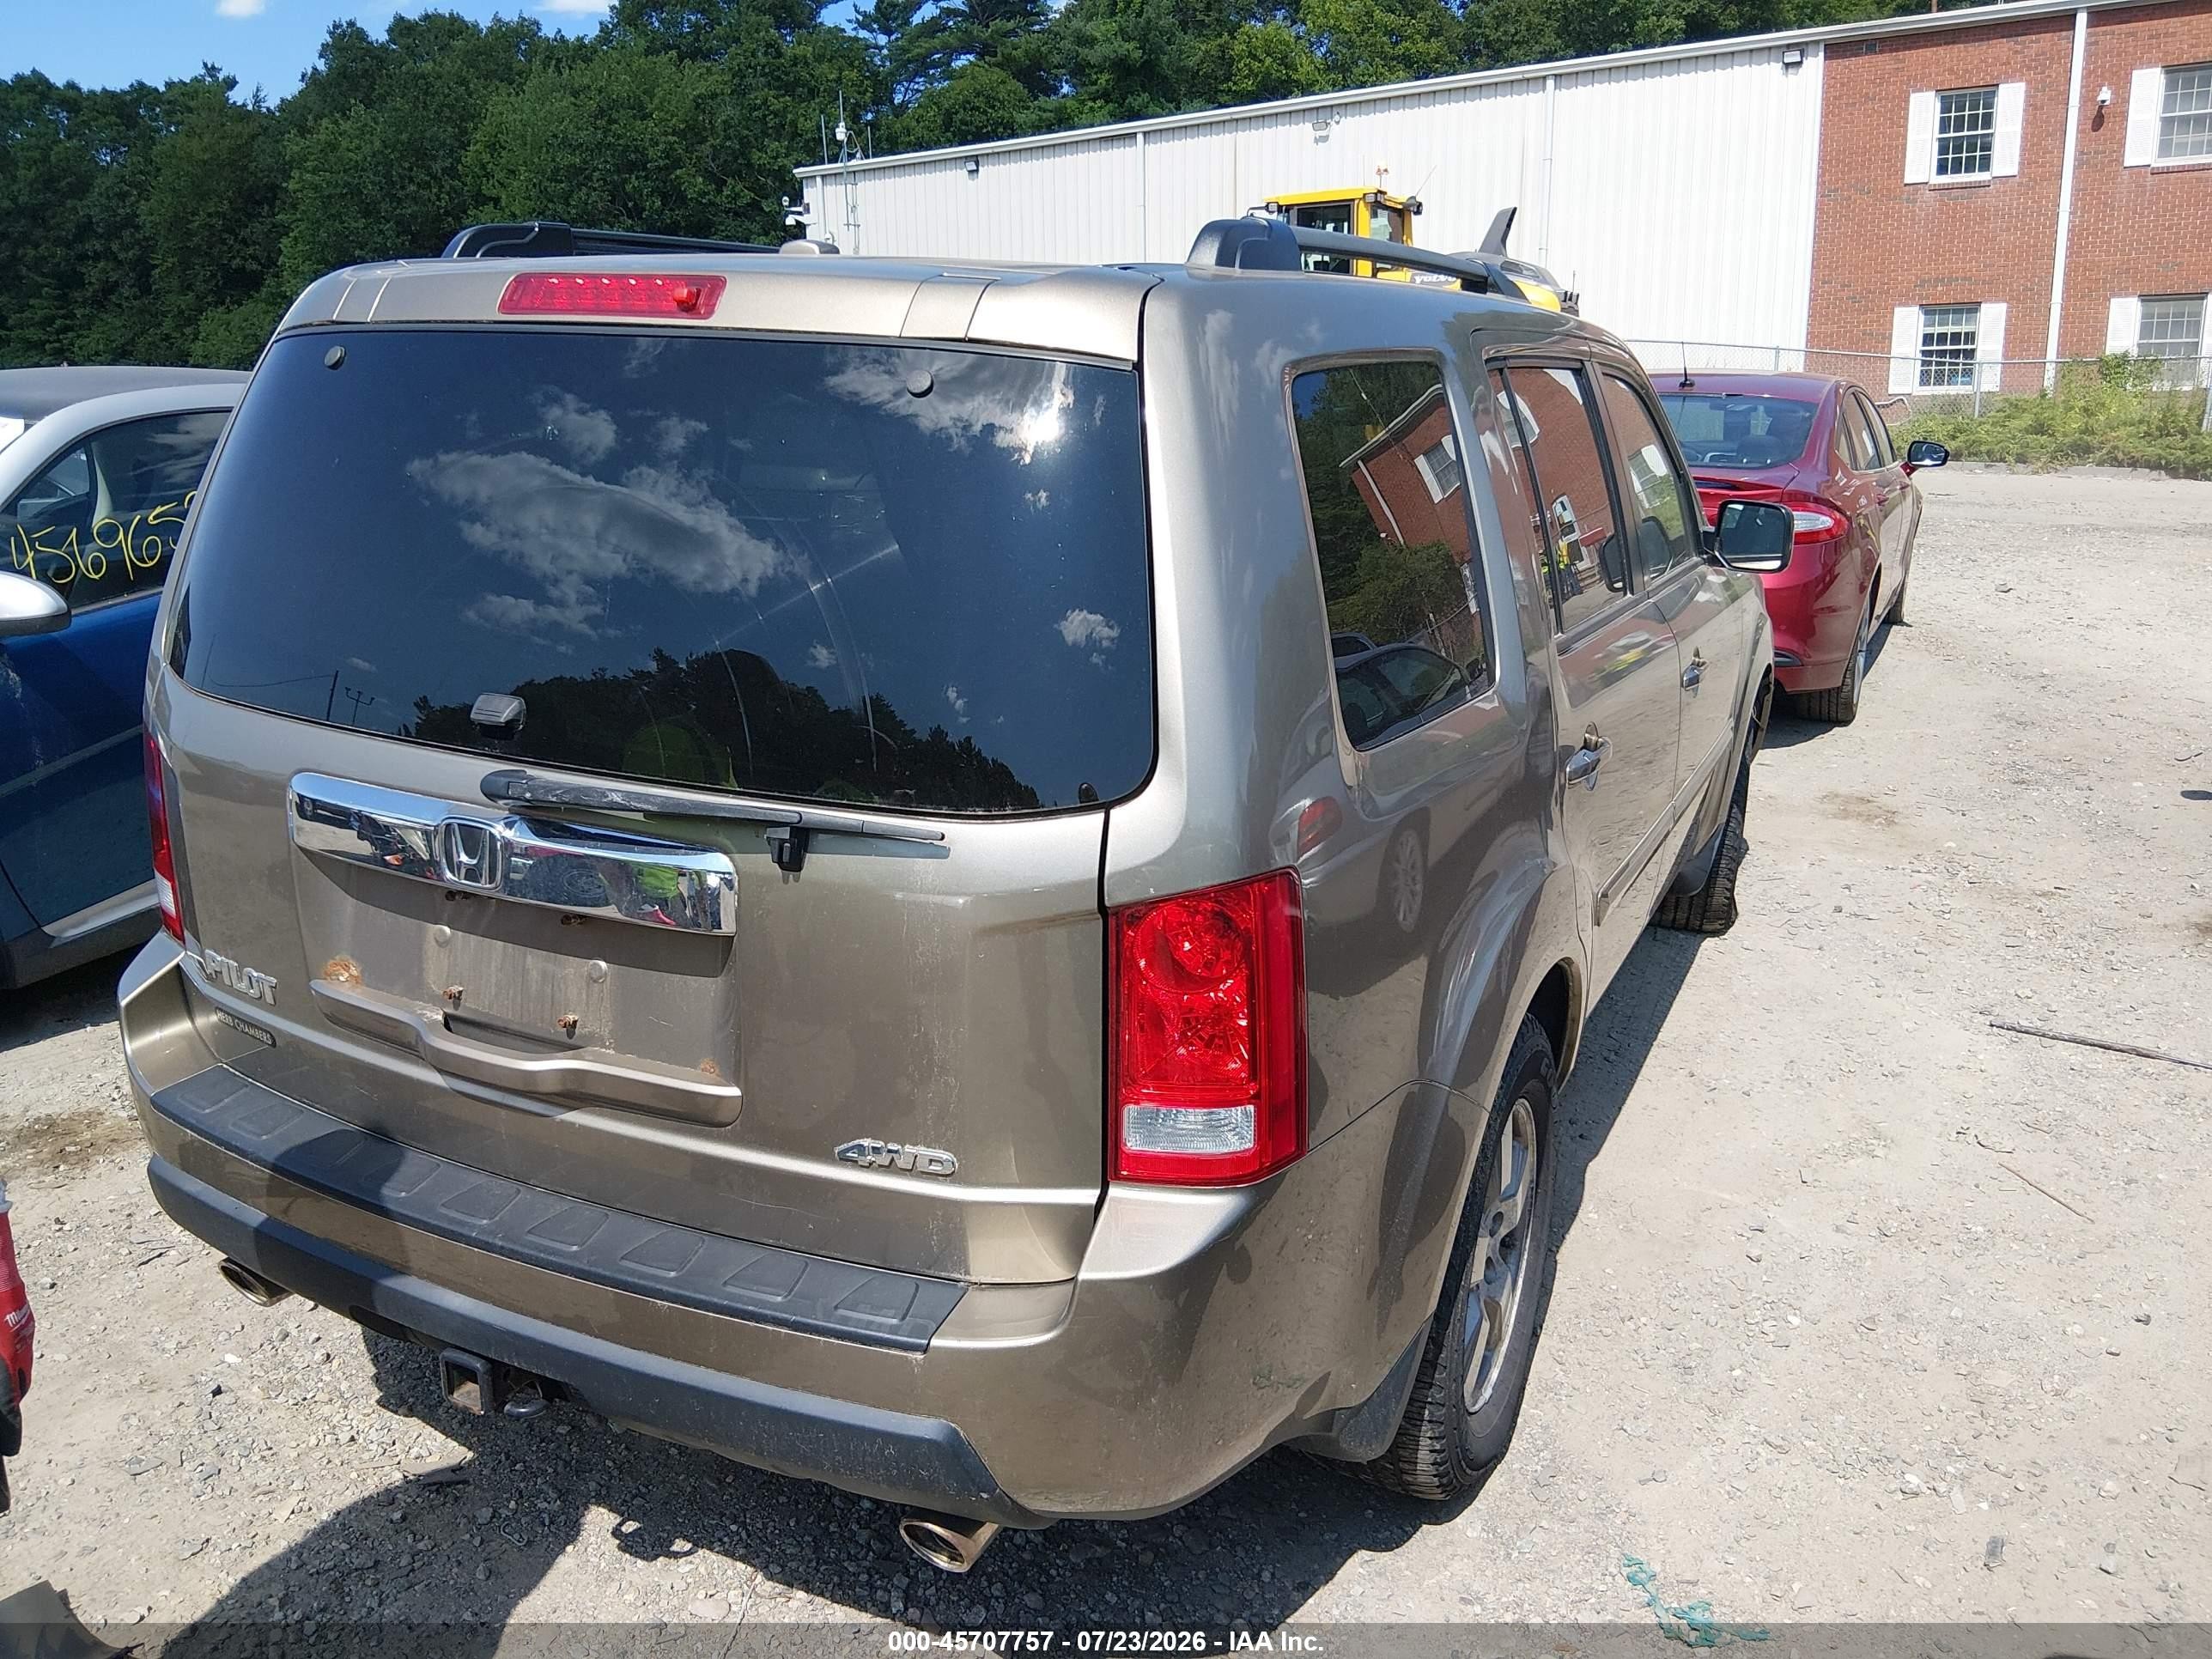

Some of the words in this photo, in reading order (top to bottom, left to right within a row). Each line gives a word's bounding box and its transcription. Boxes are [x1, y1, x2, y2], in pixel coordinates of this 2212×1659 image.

[204, 949, 278, 1006] PILOT
[234, 1018, 272, 1045] CHAMBERS
[834, 1138, 959, 1177] 4WD
